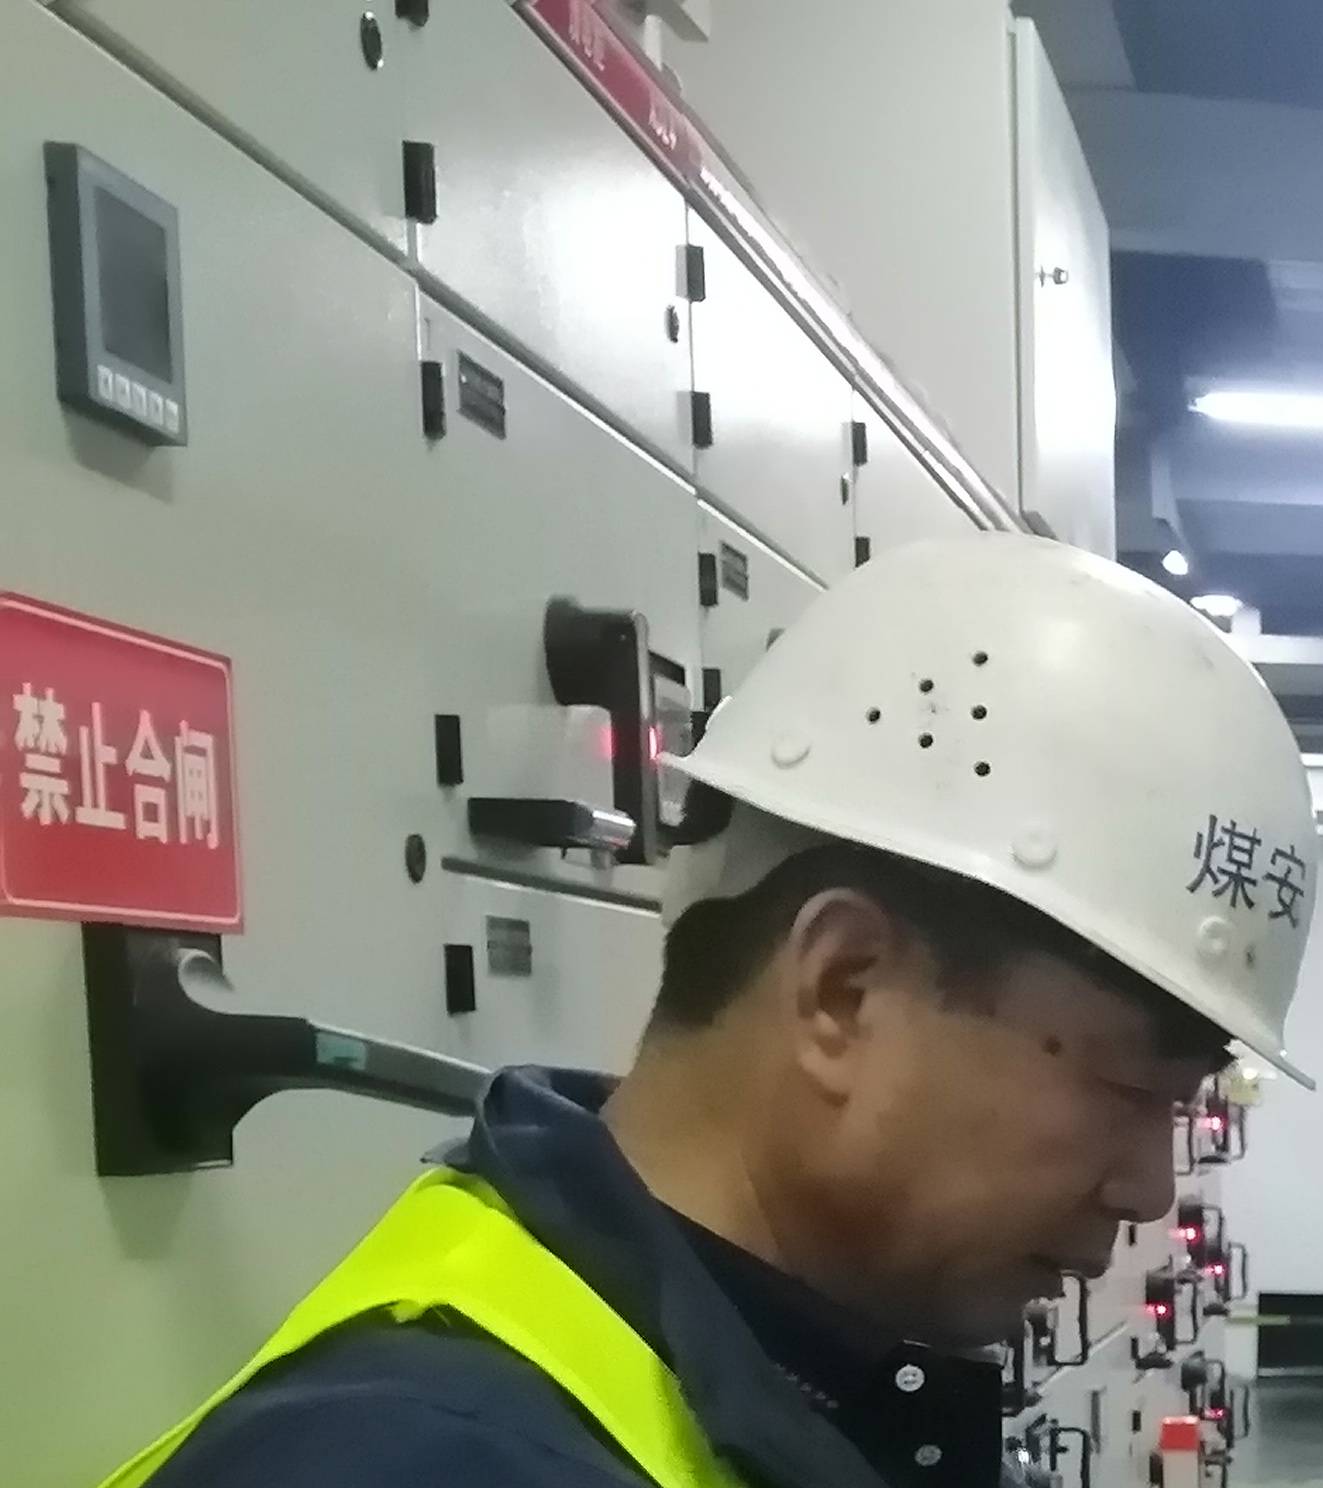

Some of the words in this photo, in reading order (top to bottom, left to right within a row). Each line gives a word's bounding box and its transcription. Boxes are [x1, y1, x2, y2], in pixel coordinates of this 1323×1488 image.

[13, 682, 219, 850] 禁止合闸
[1186, 814, 1307, 929] 煤安
